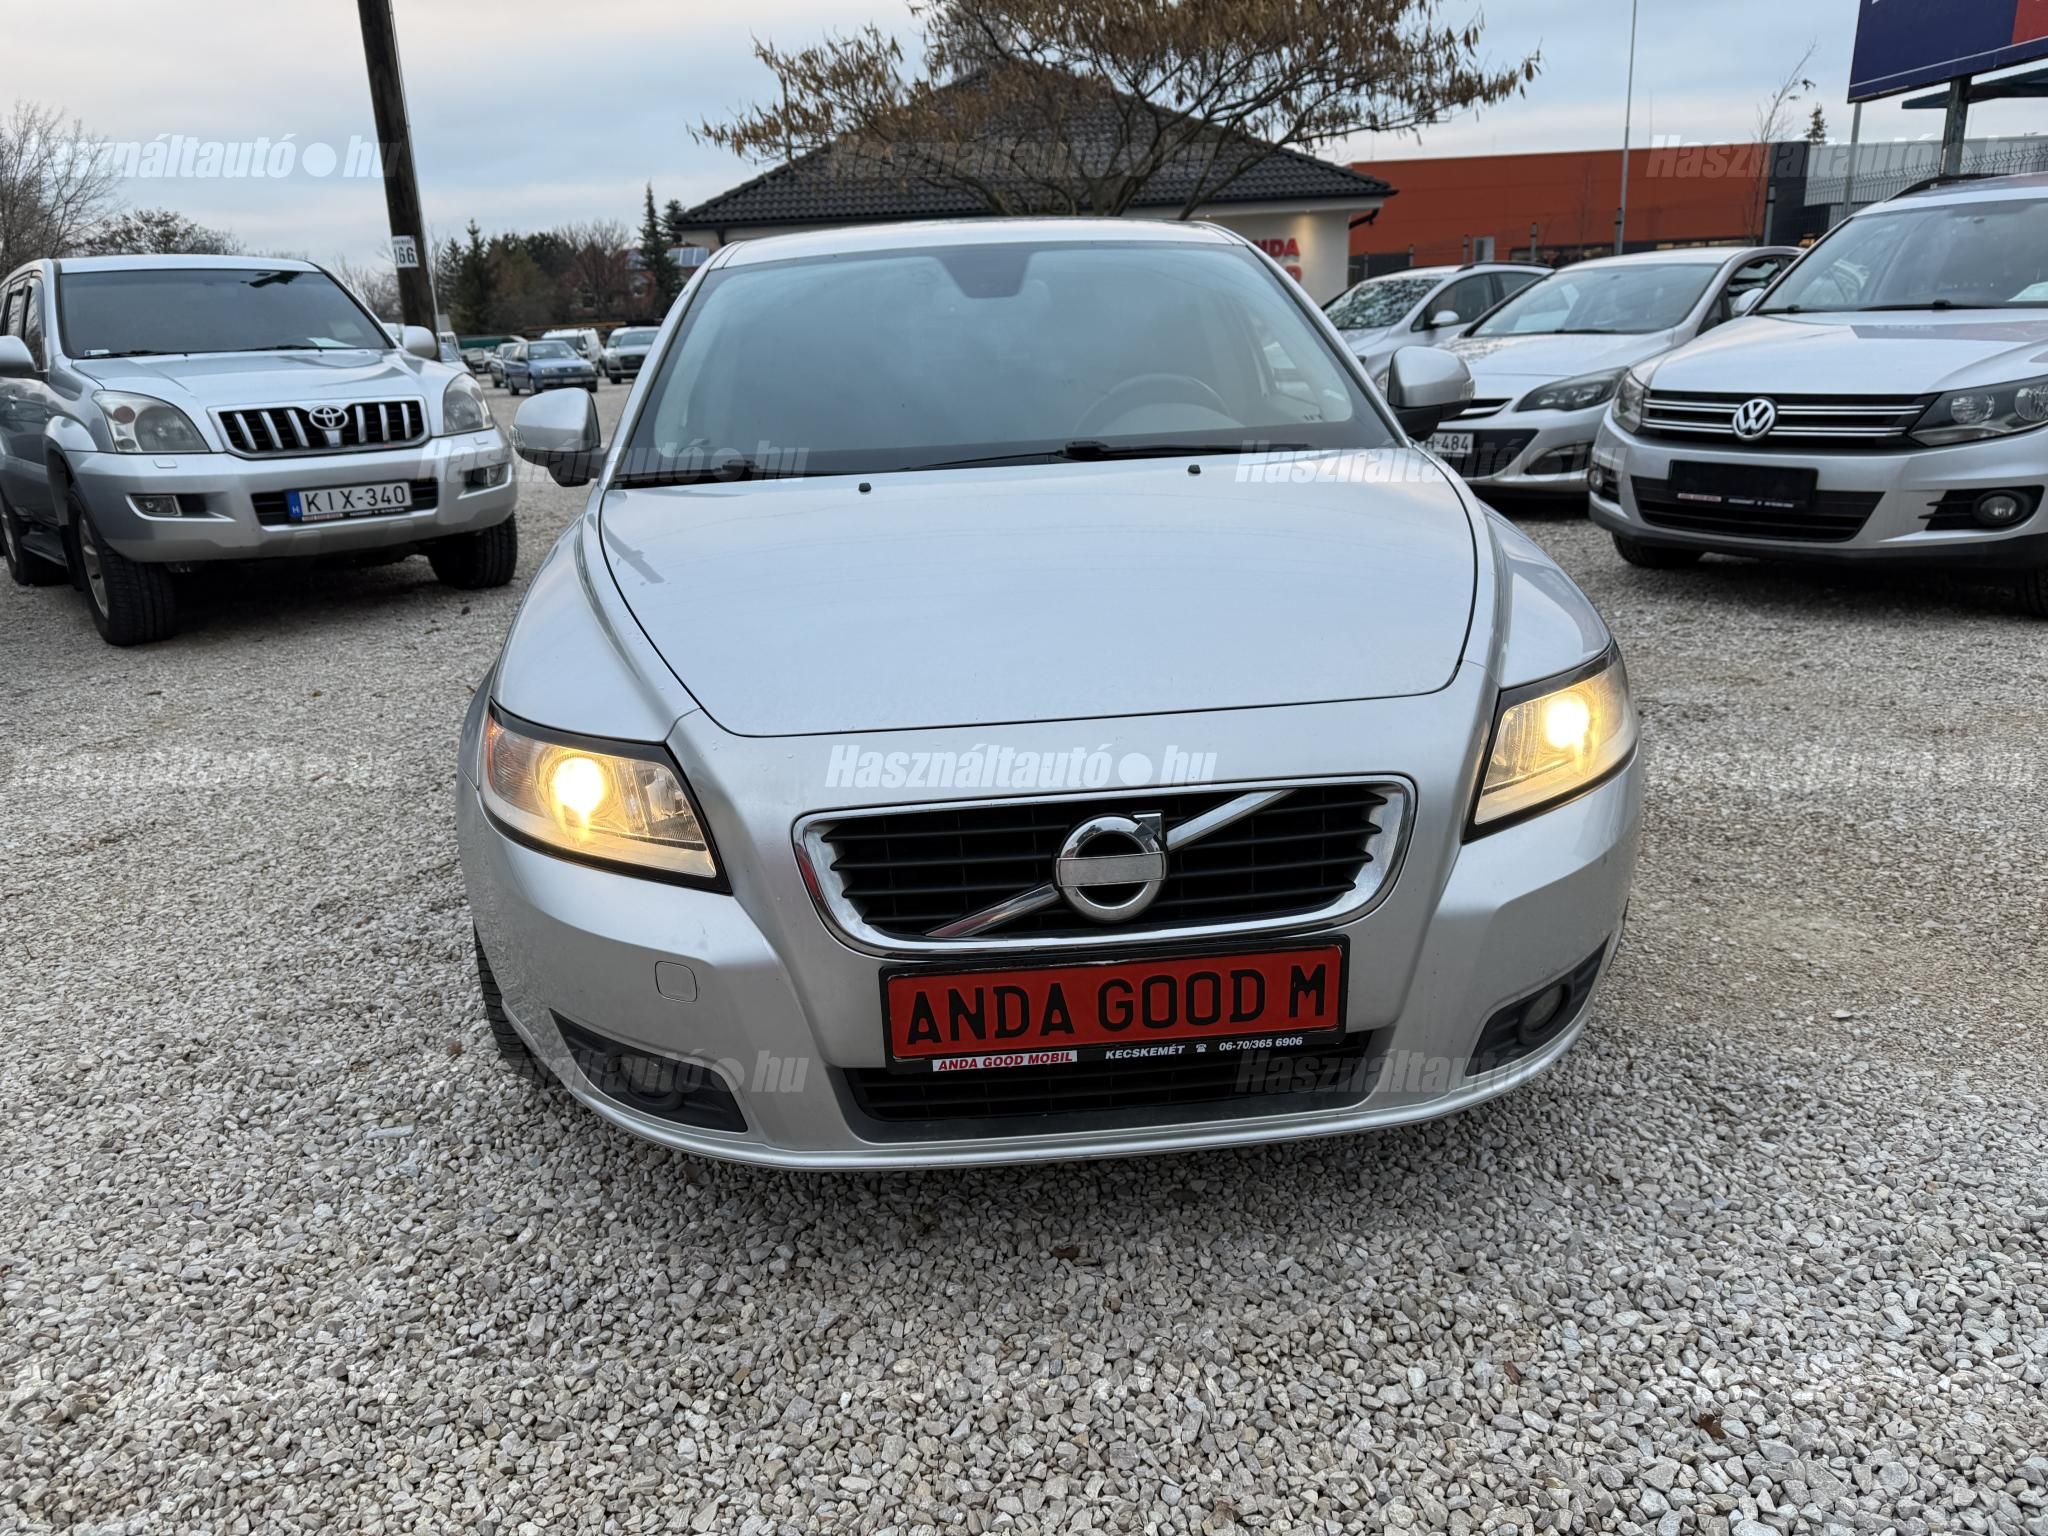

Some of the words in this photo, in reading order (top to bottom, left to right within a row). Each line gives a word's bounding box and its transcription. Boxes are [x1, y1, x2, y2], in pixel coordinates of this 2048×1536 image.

[1252, 238, 1300, 257] NDA
[1424, 435, 1468, 450] H-484
[305, 485, 405, 512] KIX-340
[907, 982, 1075, 1045] ANDA
[1097, 969, 1265, 1032] GOOD
[1288, 963, 1326, 1019] M
[1105, 1044, 1186, 1060] KECSKEMÉT
[1218, 1038, 1273, 1052] 06-70/365
[1275, 1036, 1303, 1048] 6906
[938, 1059, 978, 1072] ANDA
[982, 1055, 1024, 1068] GOOD
[1027, 1051, 1073, 1065] MOBIL
